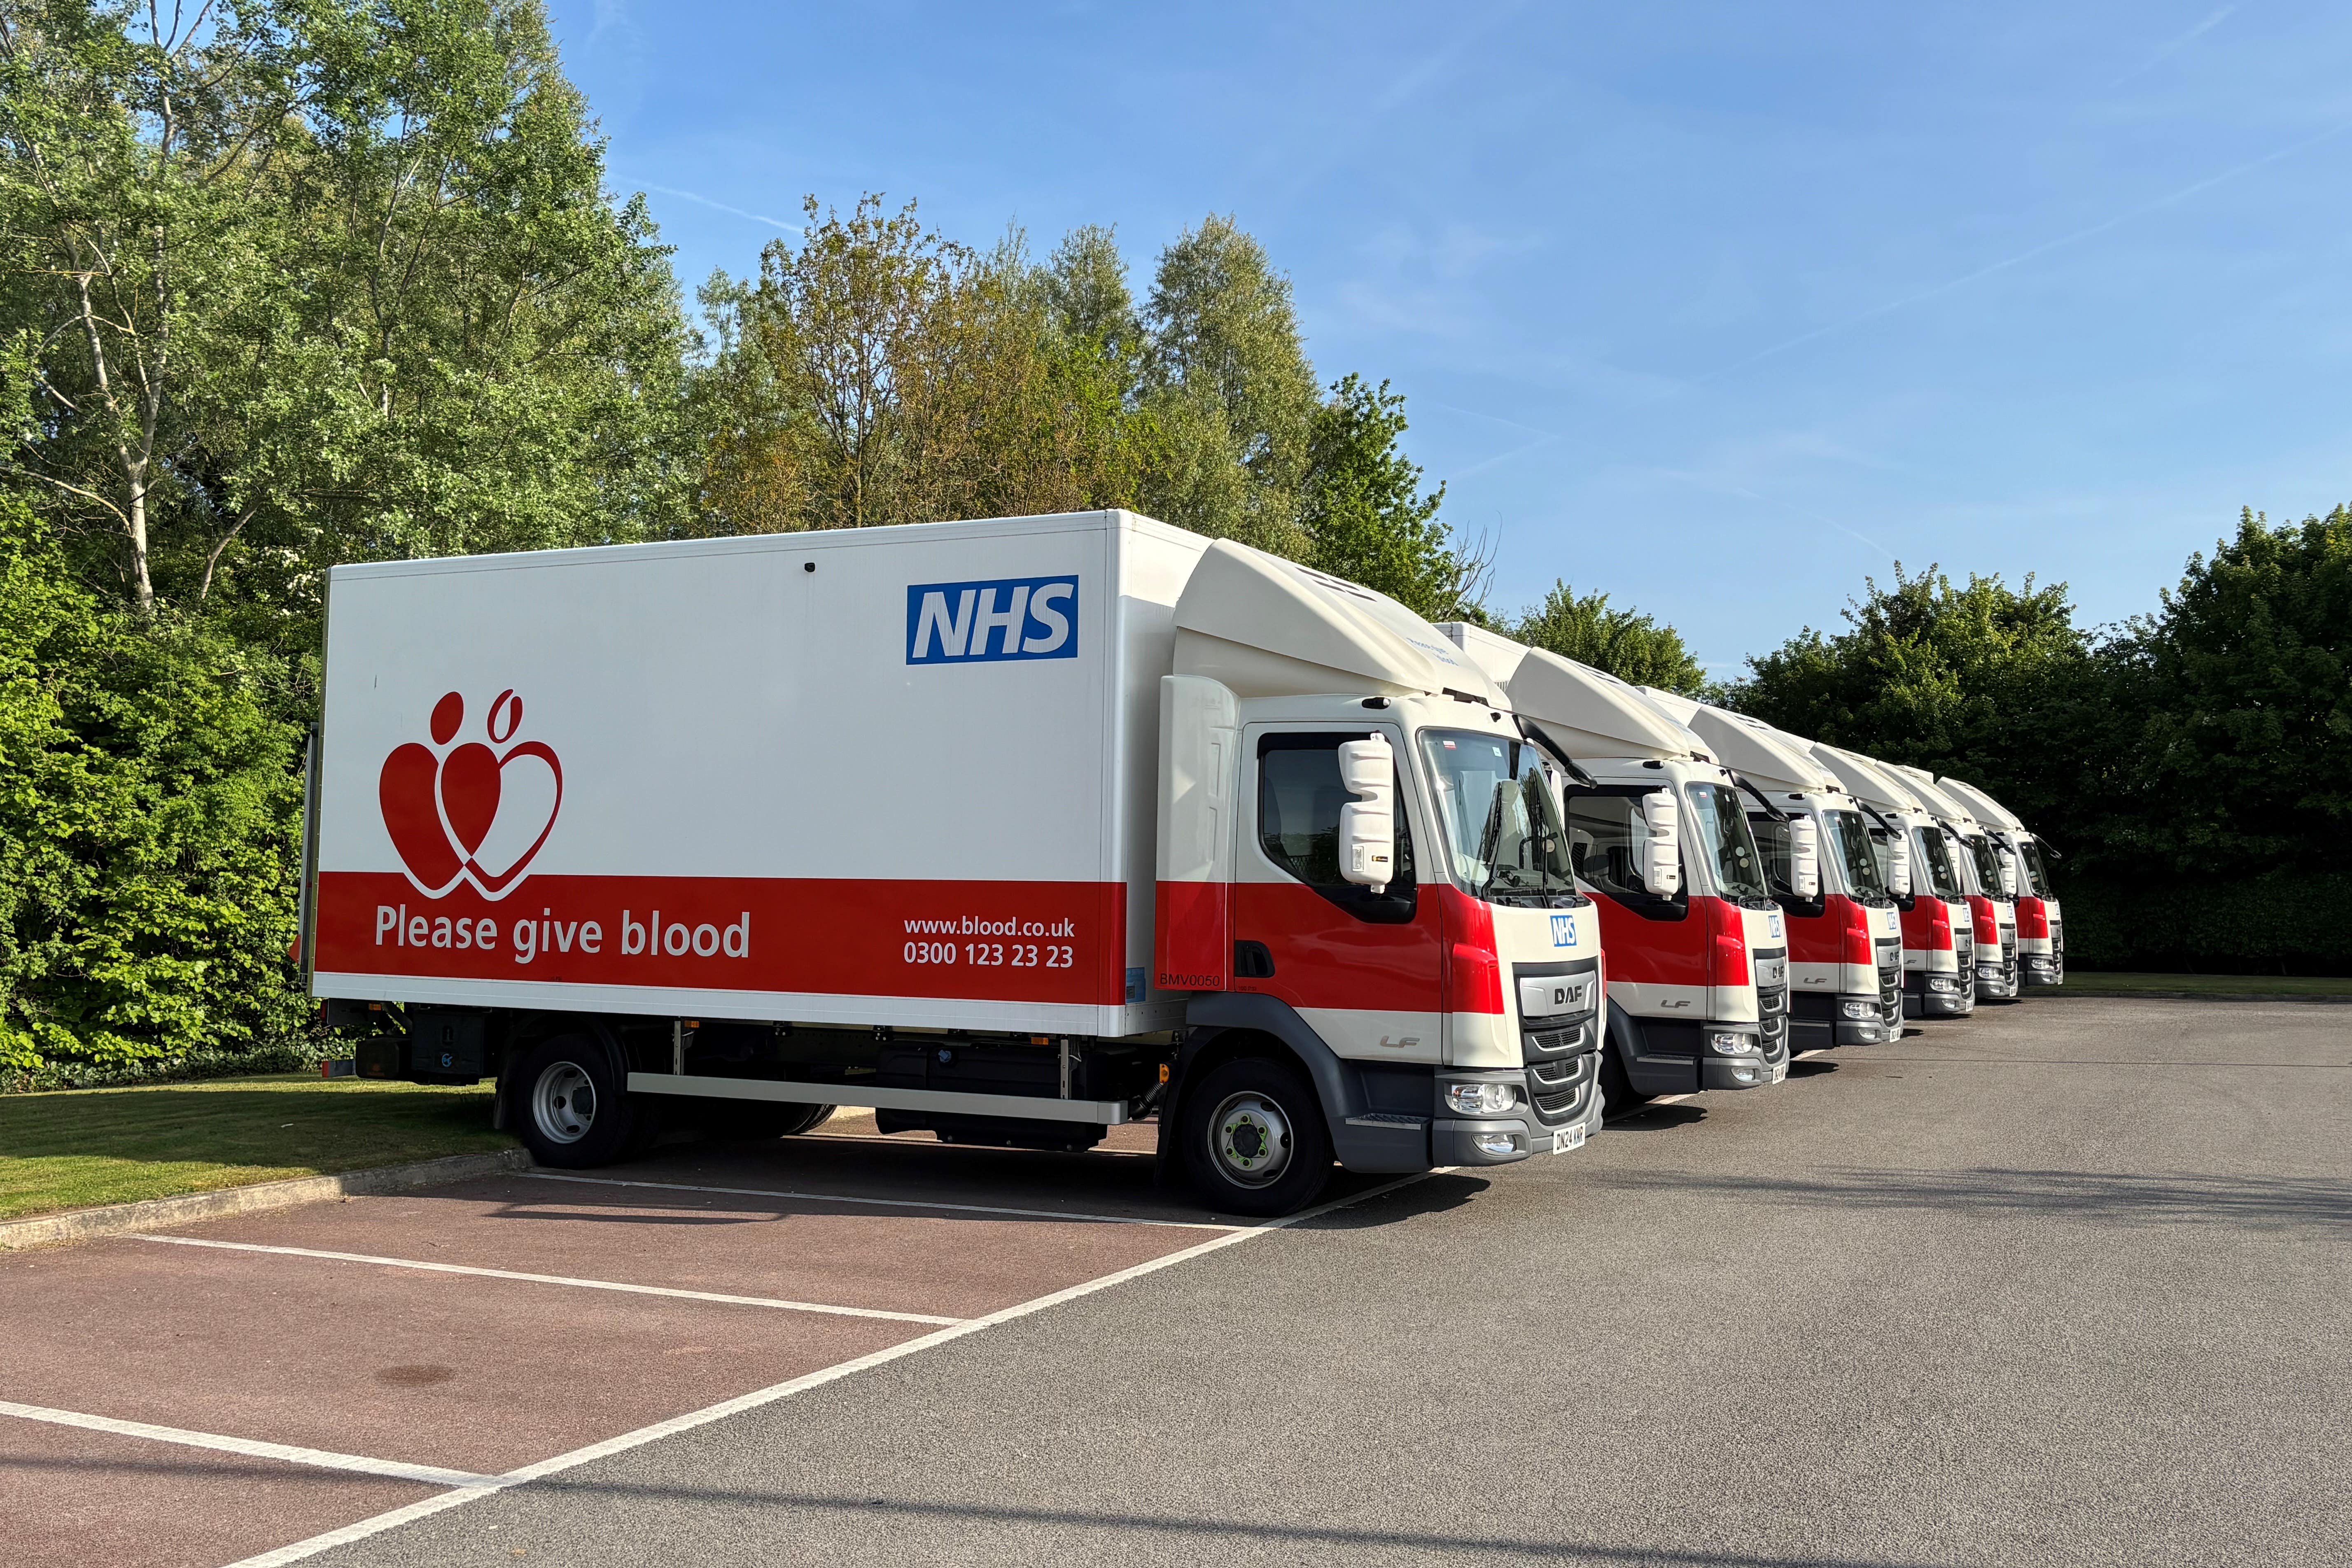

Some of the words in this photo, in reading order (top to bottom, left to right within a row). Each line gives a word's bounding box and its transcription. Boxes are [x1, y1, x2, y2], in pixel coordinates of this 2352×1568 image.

[912, 583, 1074, 658] NHS
[376, 904, 497, 950] Please
[513, 908, 602, 964] give
[621, 910, 750, 958] blood
[904, 915, 1075, 937] www.blood.co.uk
[1552, 917, 1575, 944] NHS
[904, 942, 956, 964] 0300
[965, 943, 1003, 966] 123
[1011, 944, 1038, 967] 23
[1046, 945, 1073, 968] 23
[1160, 973, 1220, 987] BMV0050
[1554, 985, 1582, 1005] DAF
[1660, 999, 1691, 1008] LF
[1380, 1035, 1420, 1048] LF
